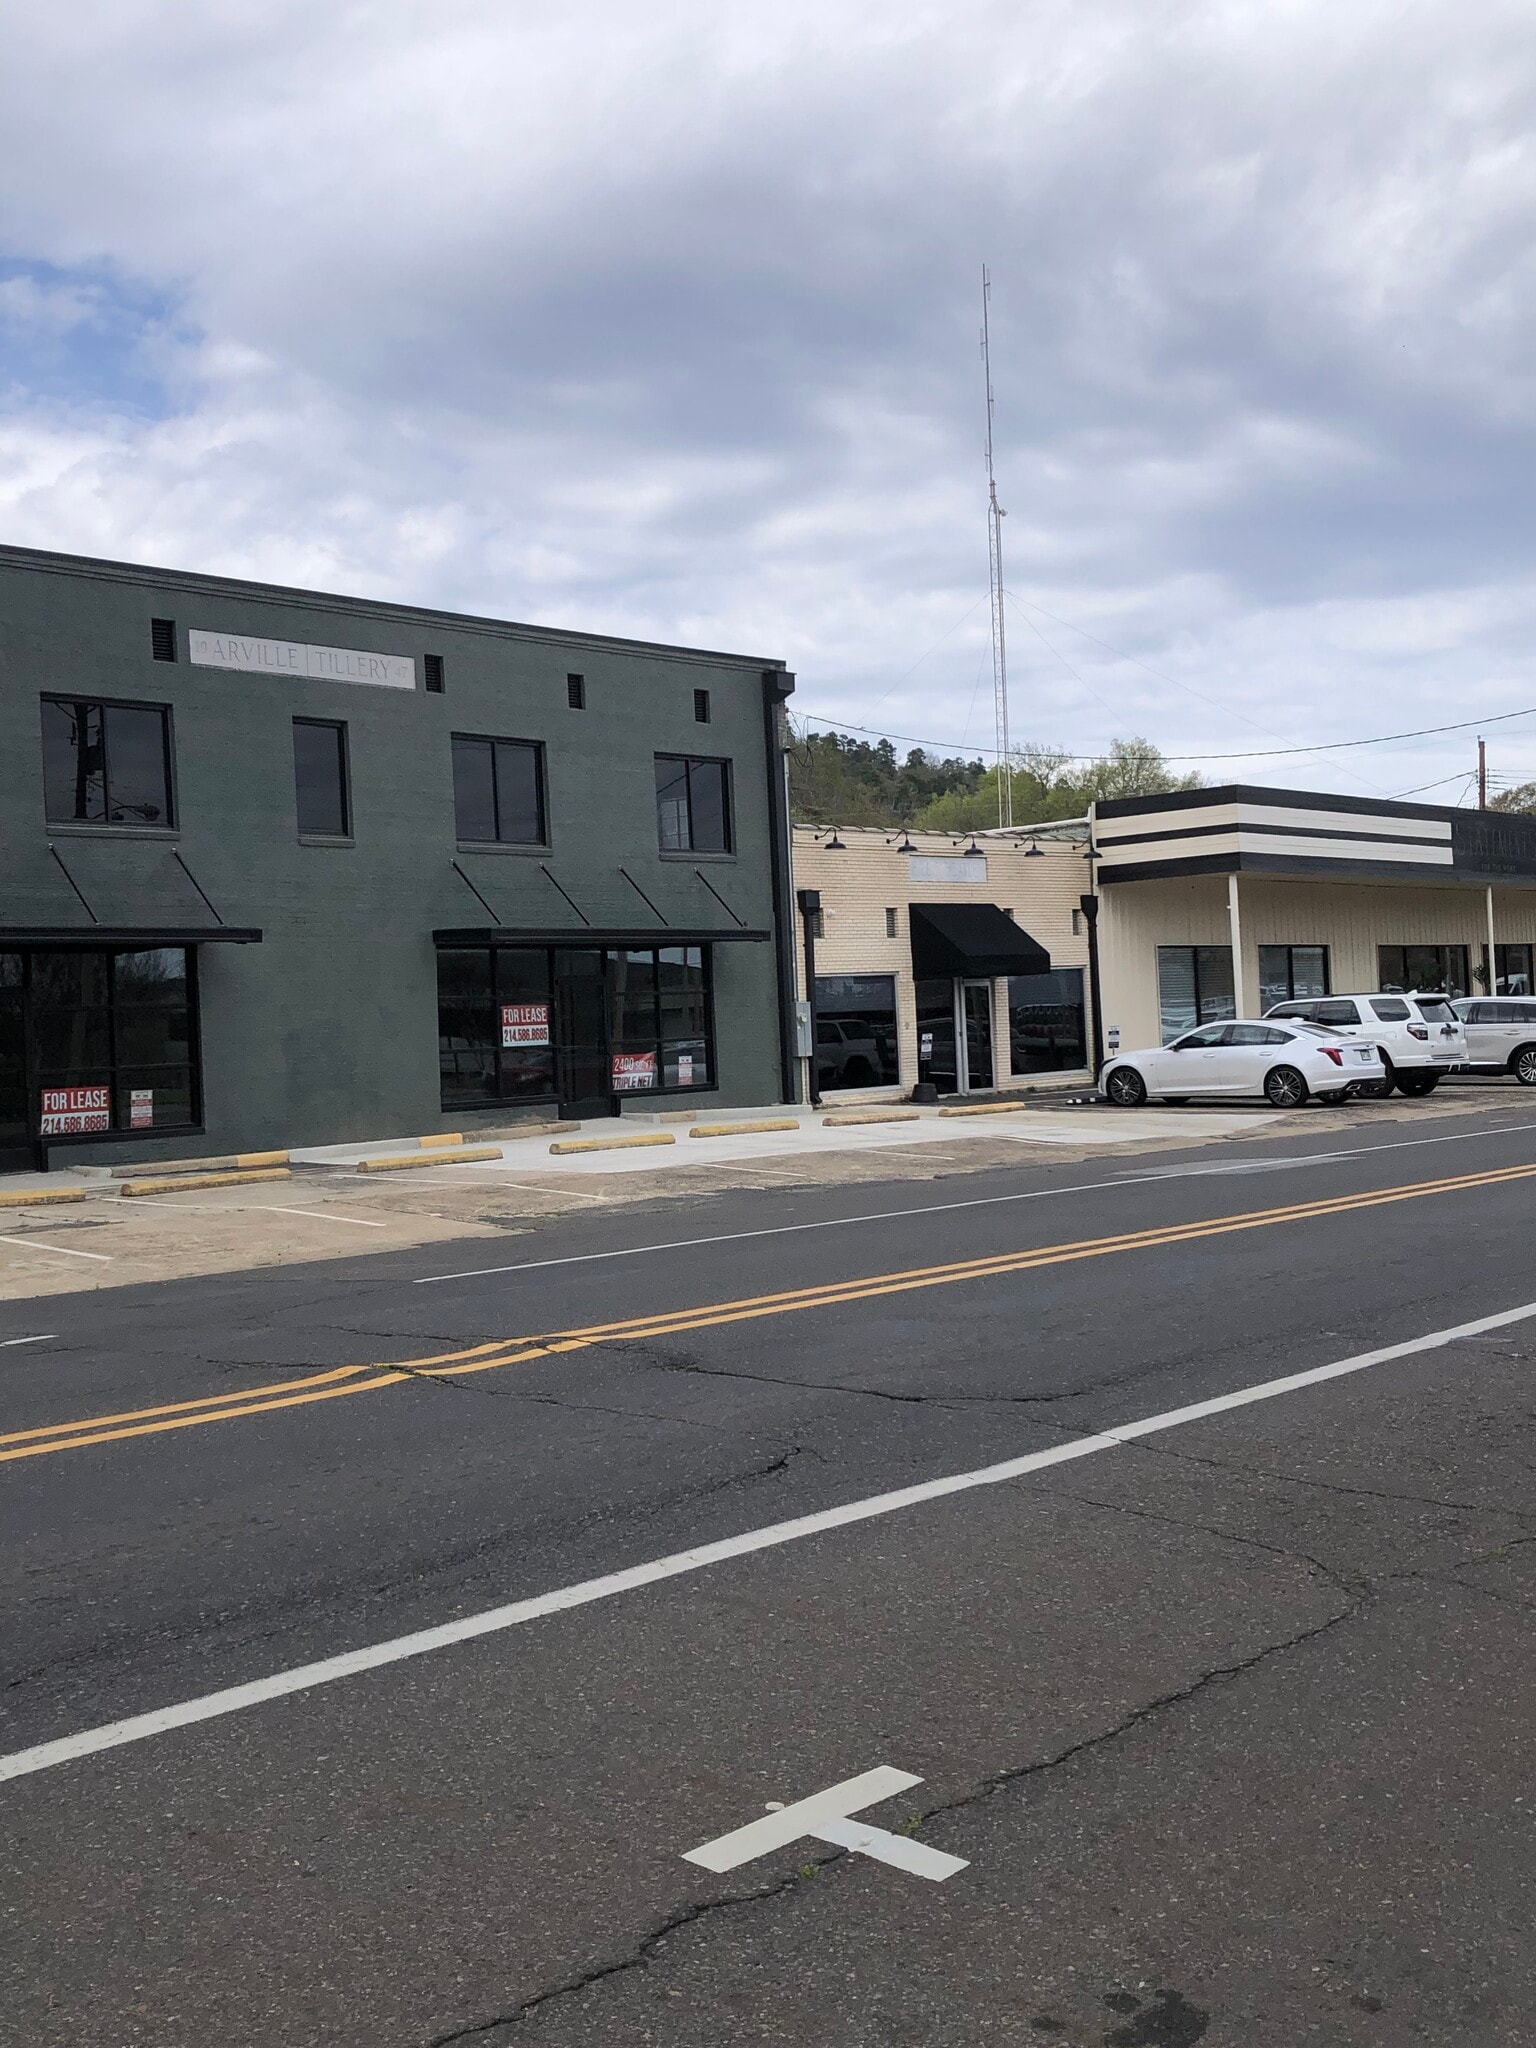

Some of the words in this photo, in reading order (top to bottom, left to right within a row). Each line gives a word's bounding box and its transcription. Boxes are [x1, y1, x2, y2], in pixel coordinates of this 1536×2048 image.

[212, 639, 299, 669] ARVILLE
[315, 651, 391, 679] TILLERY
[503, 1008, 519, 1024] FOR
[520, 1007, 547, 1023] LEASE
[614, 1057, 634, 1072] 2400
[612, 1076, 637, 1090] TRIPLE
[638, 1075, 652, 1088] NET
[44, 1092, 68, 1111] FOR
[70, 1089, 108, 1109] LEASE
[43, 1114, 108, 1134] 214.586.8685
